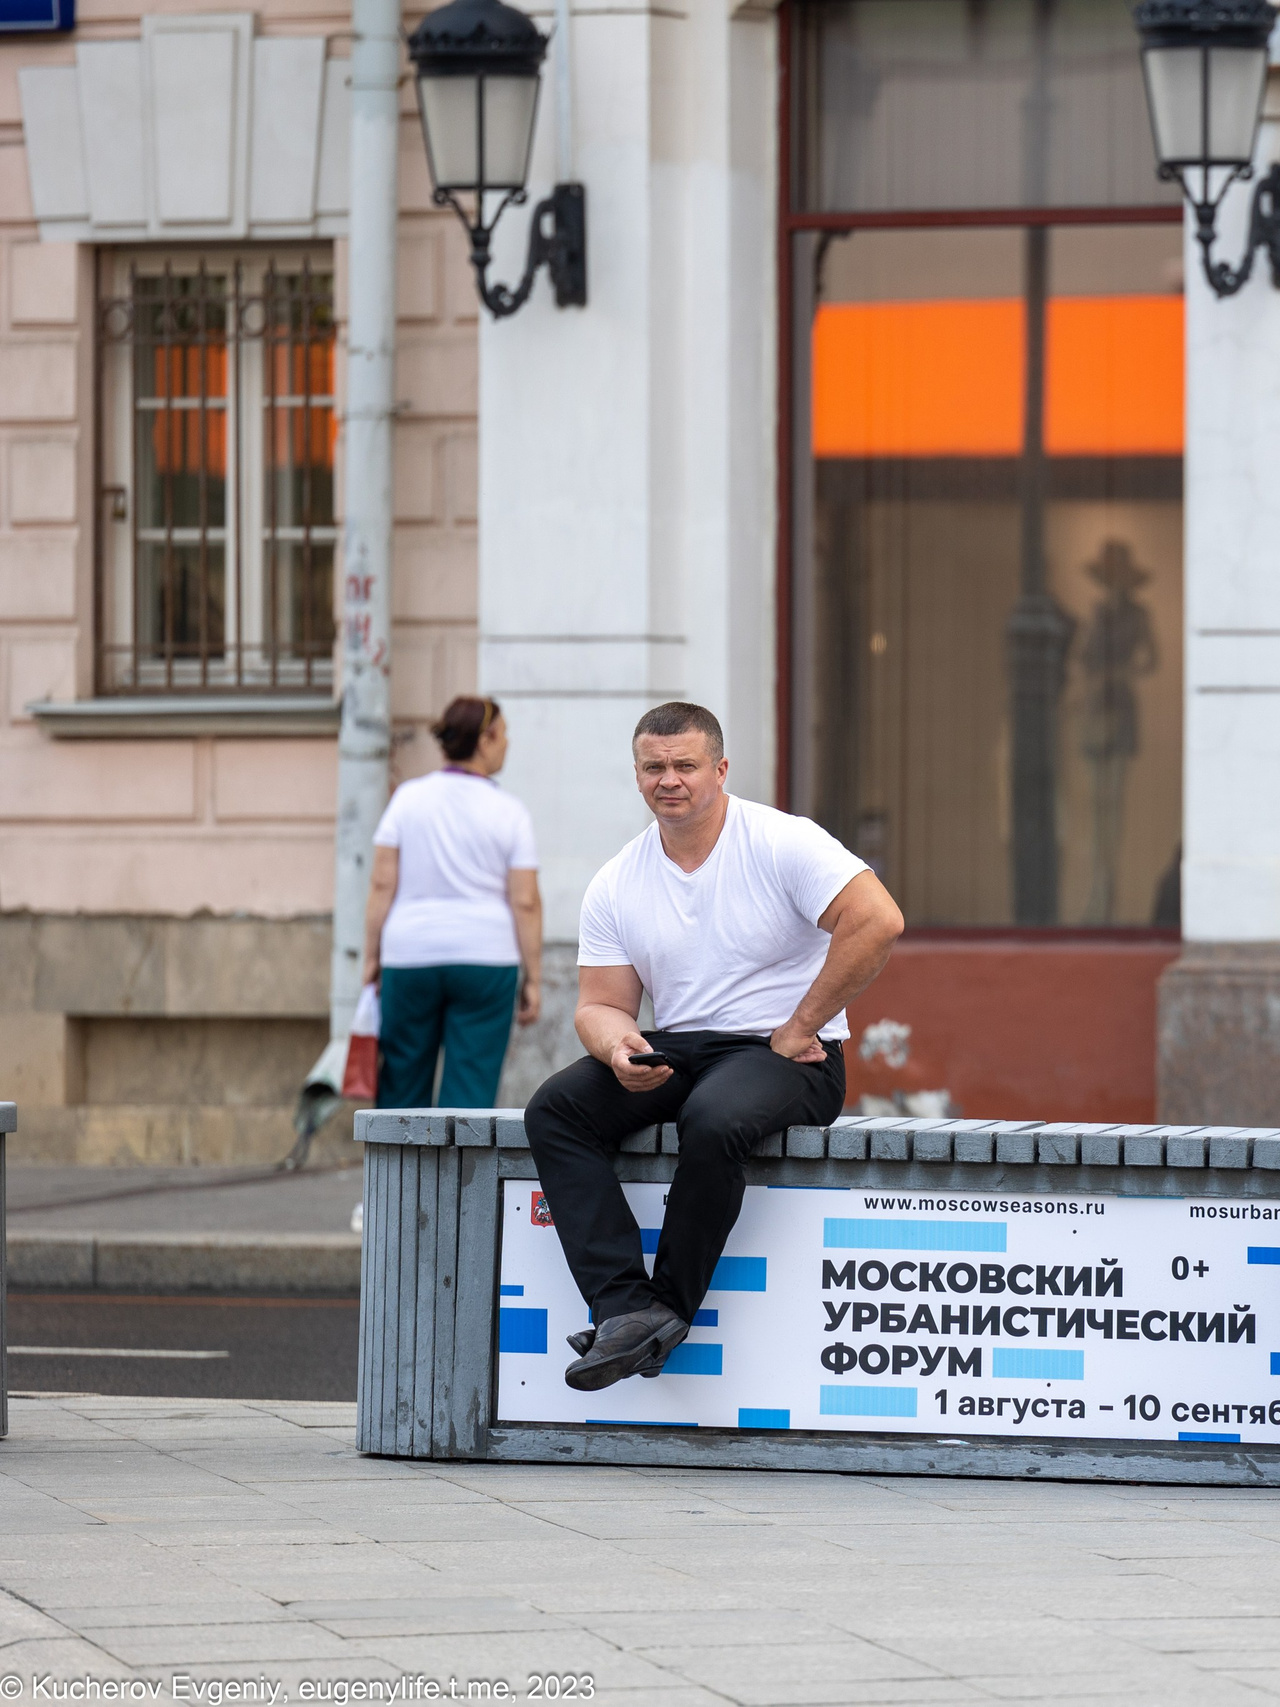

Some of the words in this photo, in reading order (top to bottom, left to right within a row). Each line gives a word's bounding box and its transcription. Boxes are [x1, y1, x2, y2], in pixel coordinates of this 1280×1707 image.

[864, 1196, 1106, 1215] www.moscowseasons.ru
[821, 1257, 1124, 1298] МОСКОВСКИЙ
[1171, 1255, 1210, 1281] 0+
[822, 1301, 1256, 1345] УРБАНИСТИЧЕСКИЙ
[820, 1342, 982, 1378] ФОРУМ
[934, 1388, 948, 1416] 1
[958, 1395, 1086, 1425] августа
[1123, 1394, 1161, 1422] 10
